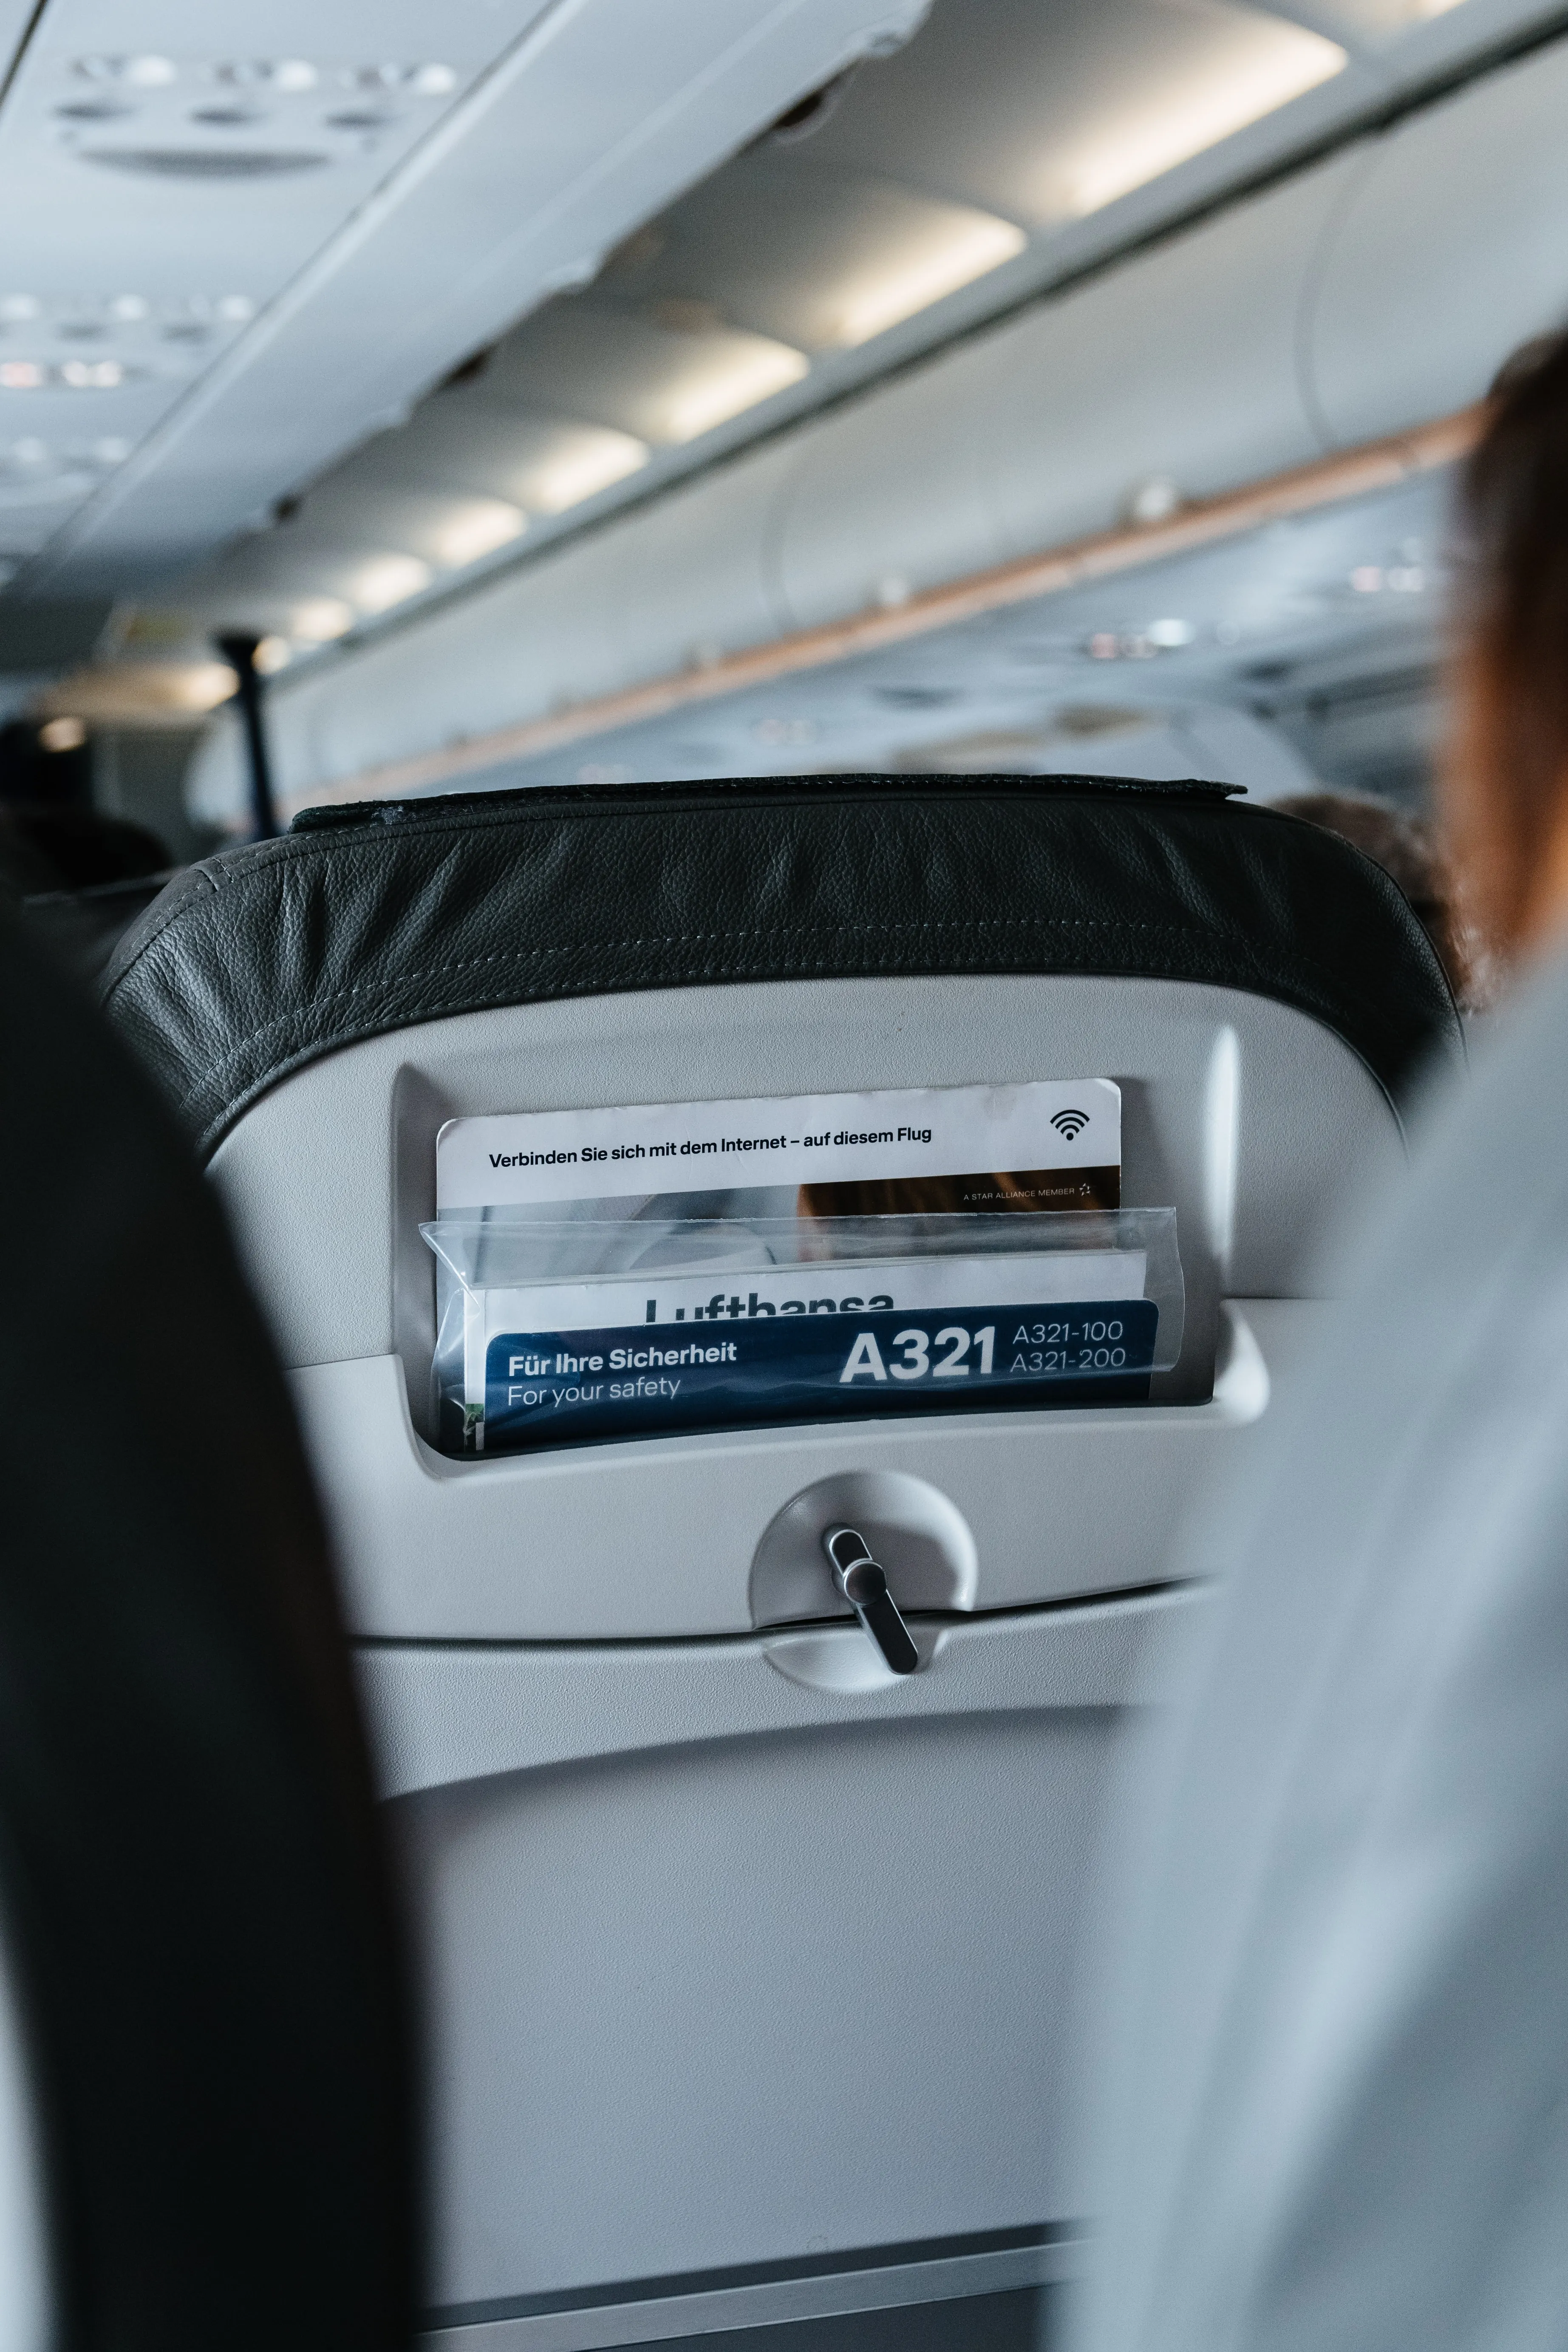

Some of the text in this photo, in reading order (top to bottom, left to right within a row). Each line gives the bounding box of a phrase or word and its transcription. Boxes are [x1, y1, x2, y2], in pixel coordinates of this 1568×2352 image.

[489, 1150, 577, 1168] Verbinden
[581, 1147, 608, 1162] Sie
[611, 1144, 645, 1160] sich
[649, 1142, 677, 1157] mit
[680, 1141, 717, 1155] dem
[722, 1135, 787, 1152] Internet
[804, 1132, 831, 1147] auf
[833, 1131, 893, 1145] diesem
[897, 1127, 931, 1143] Flug
[996, 1190, 1035, 1199] ALLIANCE
[1038, 1188, 1075, 1196] MEMBER
[1012, 1321, 1124, 1344] A321-100
[509, 1342, 738, 1377] Für Ihre Sicherheit
[839, 1326, 995, 1383] A321
[1010, 1347, 1126, 1373] A321-200
[508, 1376, 681, 1408] For your safety
